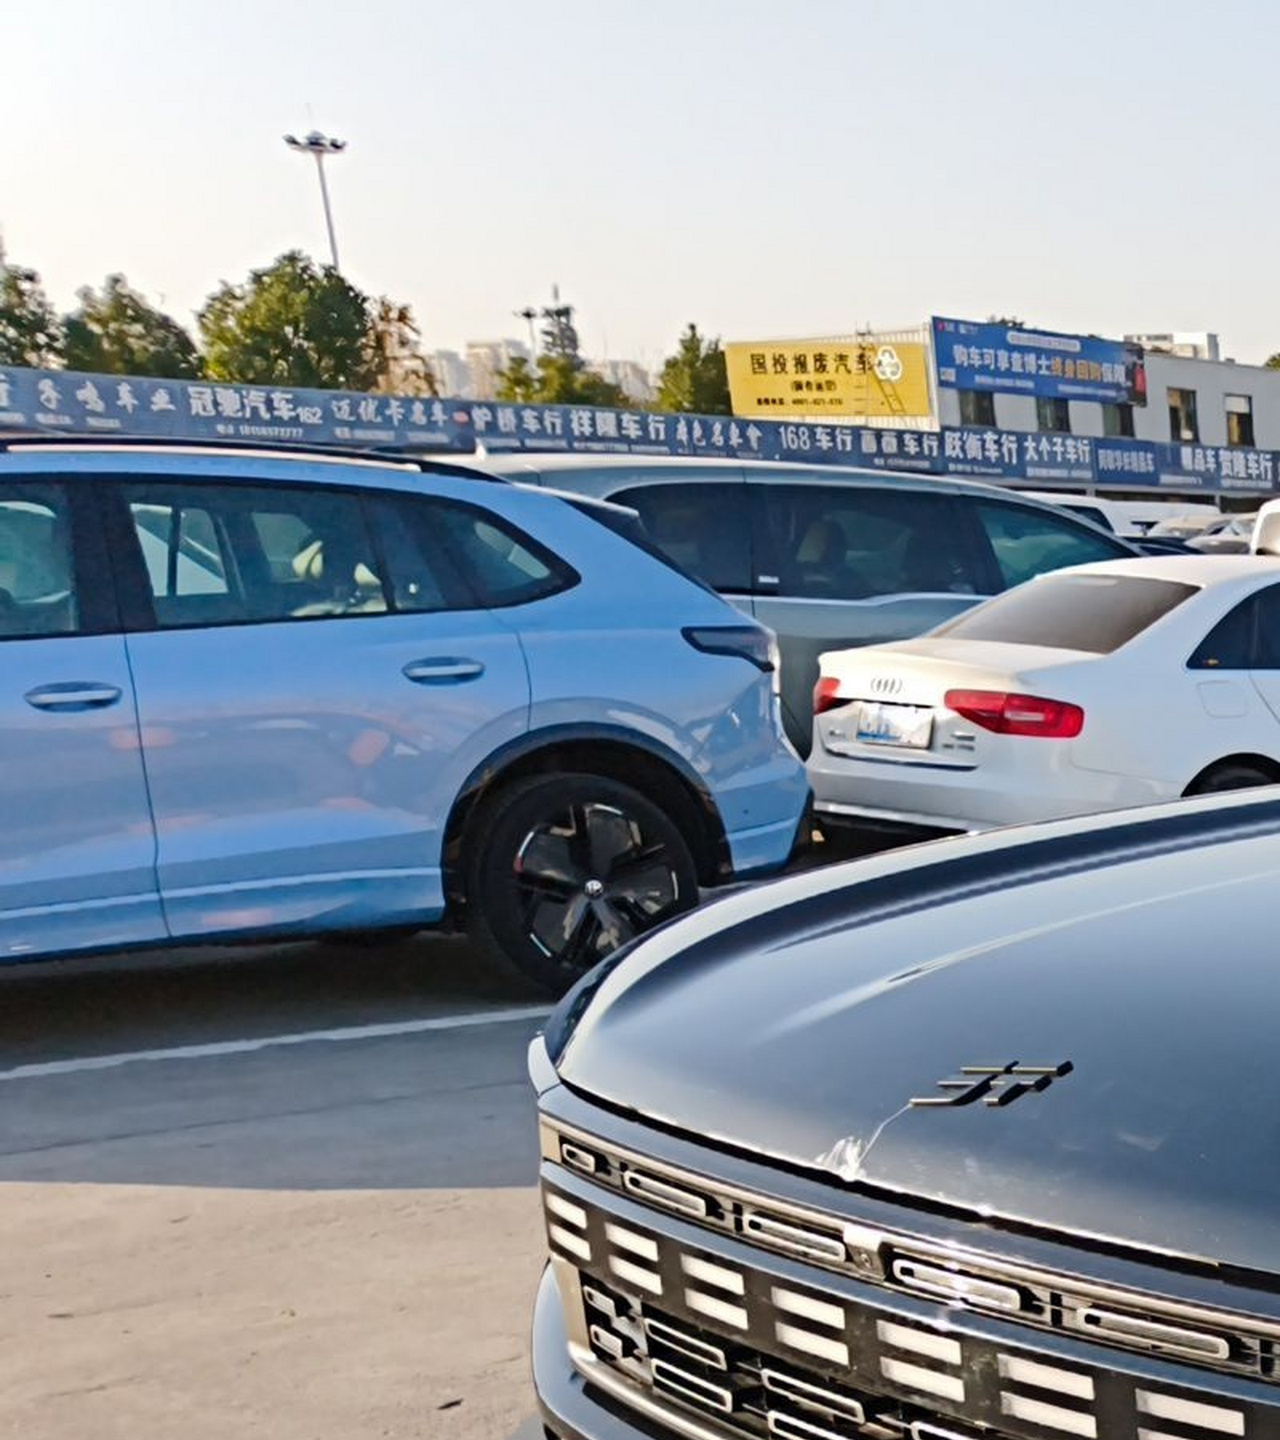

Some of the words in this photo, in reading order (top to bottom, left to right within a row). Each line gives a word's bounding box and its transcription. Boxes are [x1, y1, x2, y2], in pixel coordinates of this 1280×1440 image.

[779, 425, 853, 451] 168车行
[1024, 435, 1091, 464] 大个子车行
